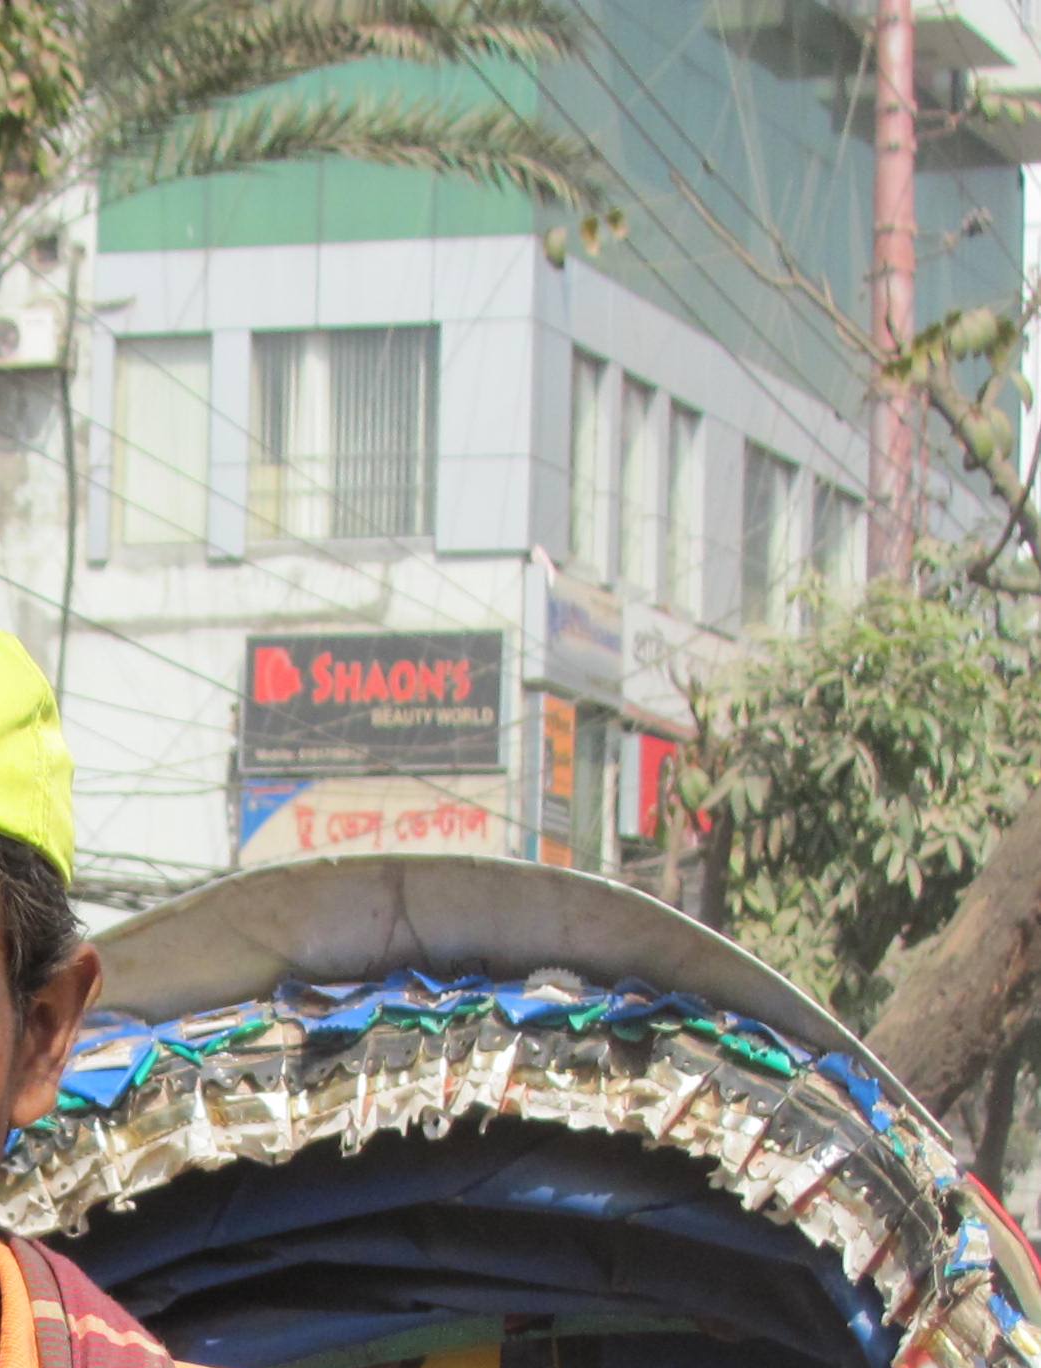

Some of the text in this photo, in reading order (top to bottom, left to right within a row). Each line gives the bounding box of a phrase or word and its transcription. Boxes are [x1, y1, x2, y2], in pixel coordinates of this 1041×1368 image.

[311, 650, 473, 704] SHAON'S
[370, 705, 495, 729] BEAUTY WORLD
